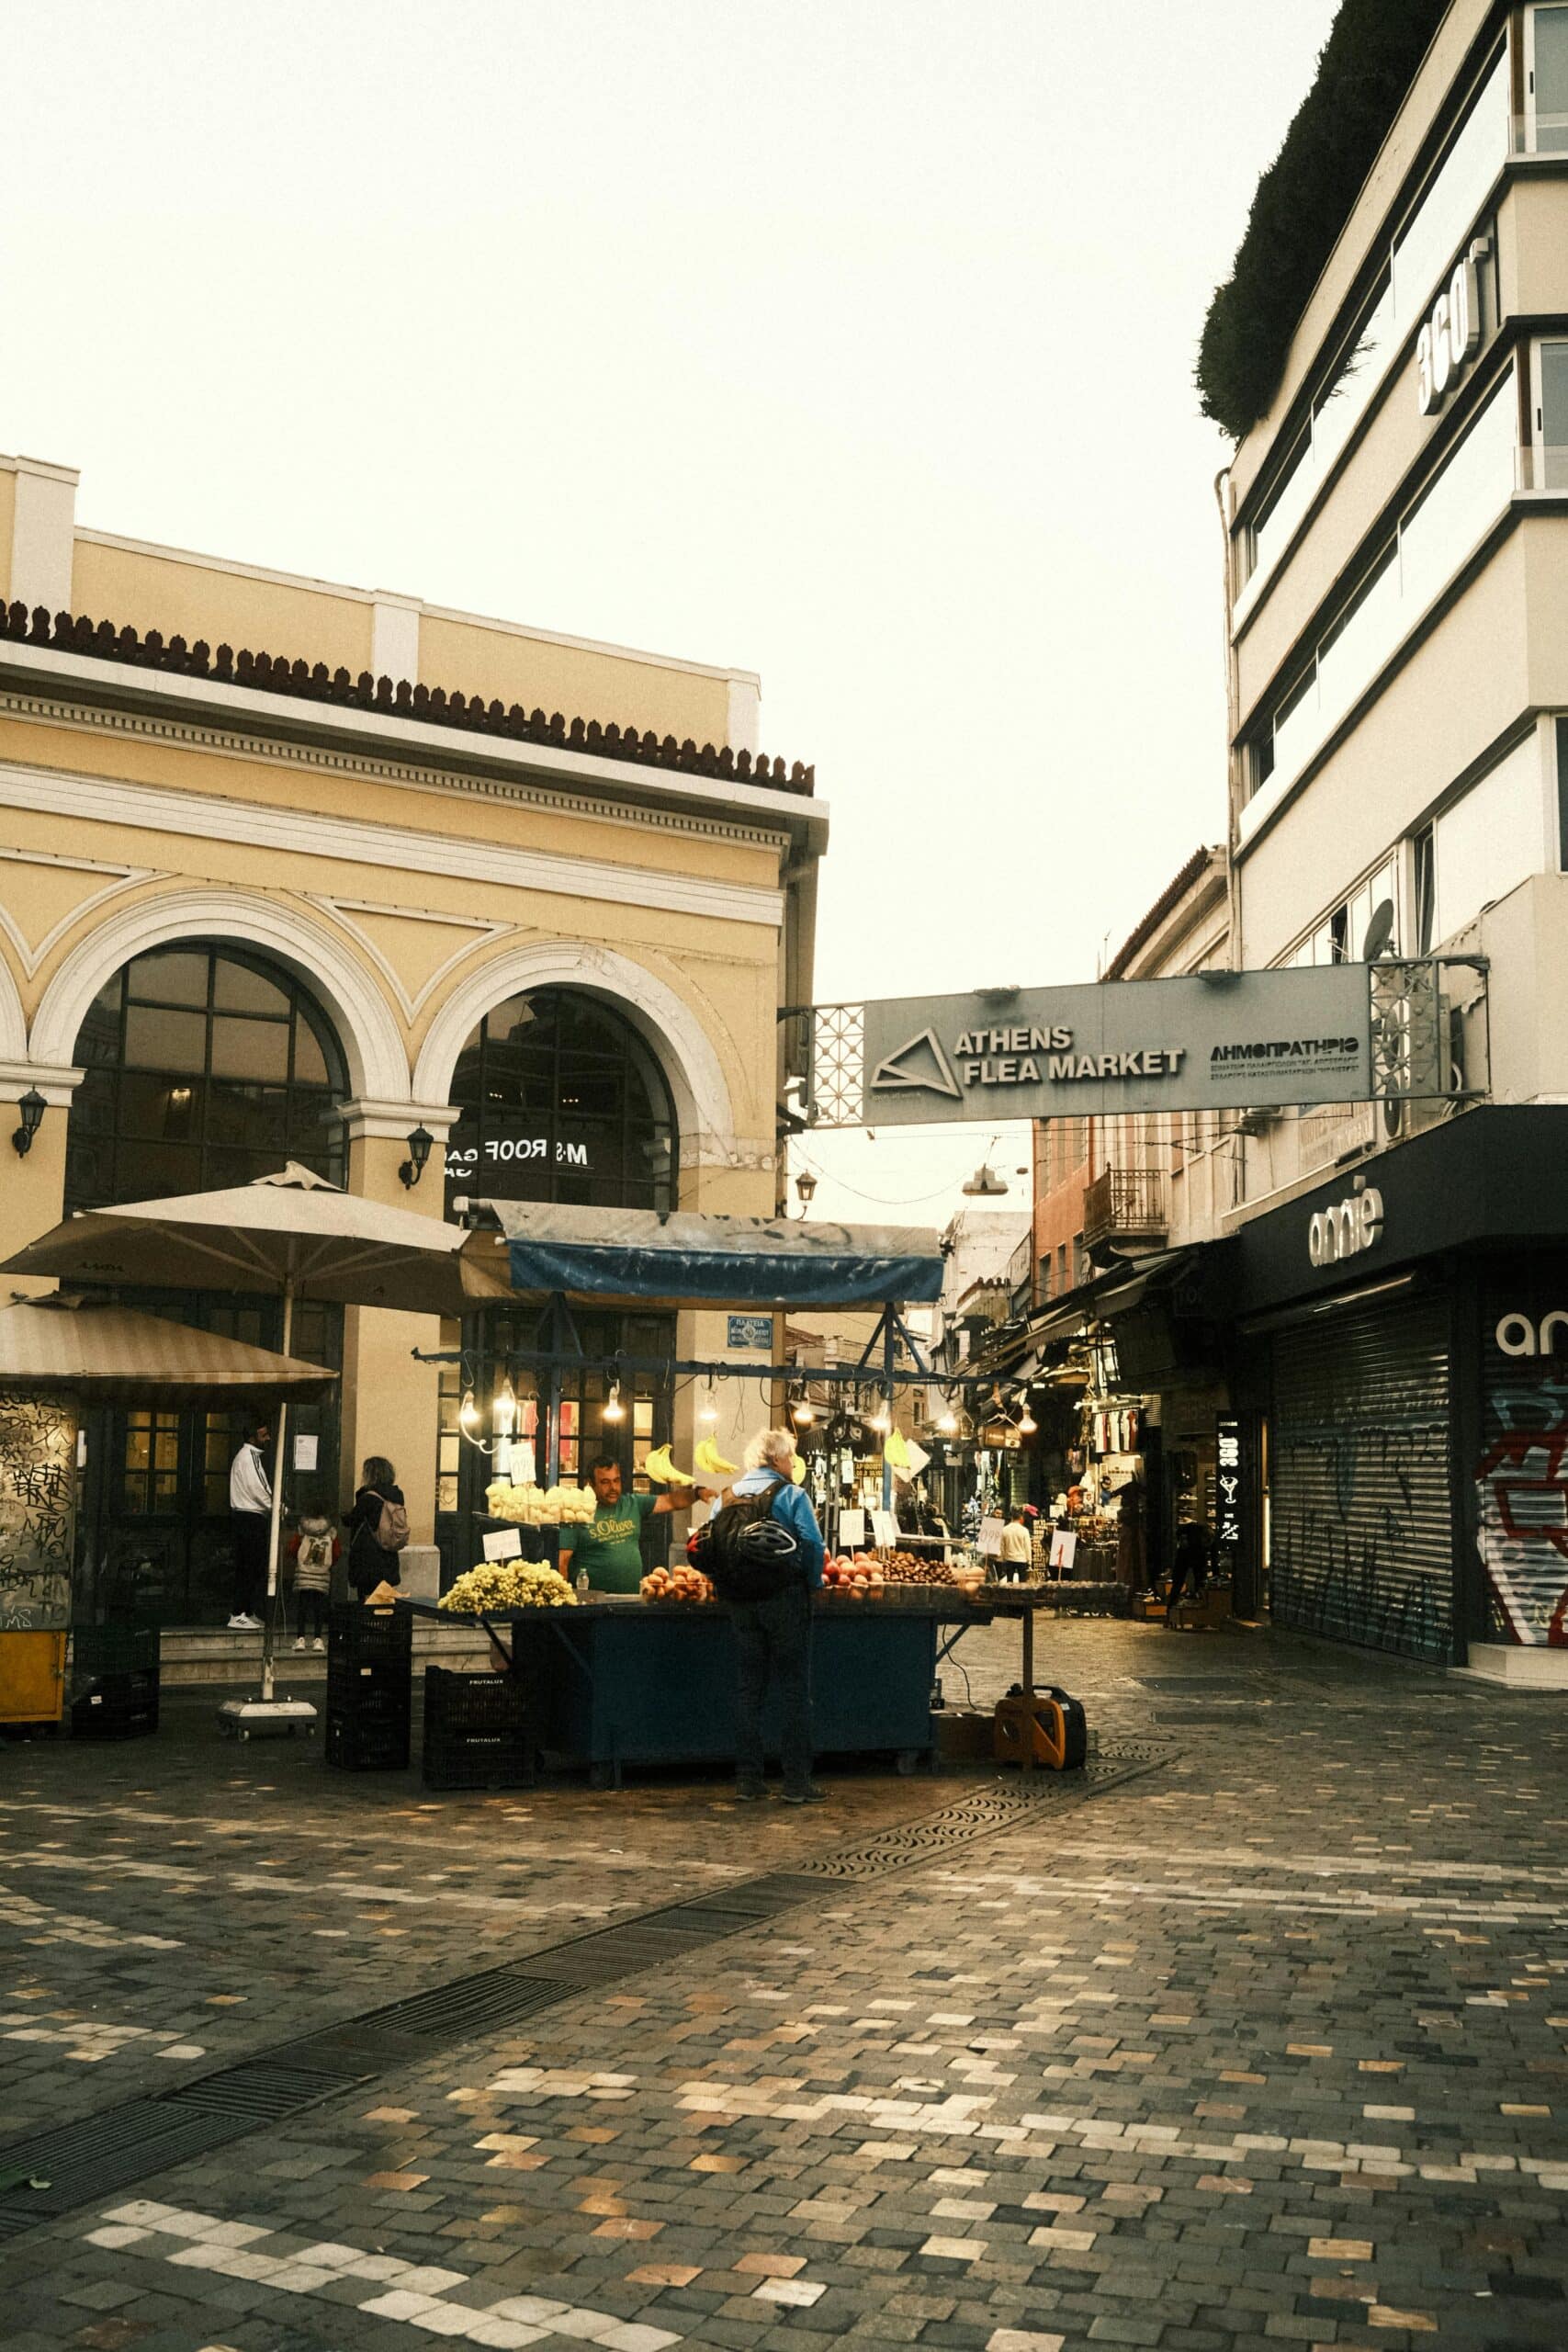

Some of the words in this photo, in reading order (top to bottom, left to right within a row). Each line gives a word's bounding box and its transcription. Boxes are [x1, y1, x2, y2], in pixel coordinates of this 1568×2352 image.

[954, 1026, 1074, 1056] ATHENS
[964, 1057, 1043, 1085] FLEA
[1048, 1048, 1185, 1080] MARKET
